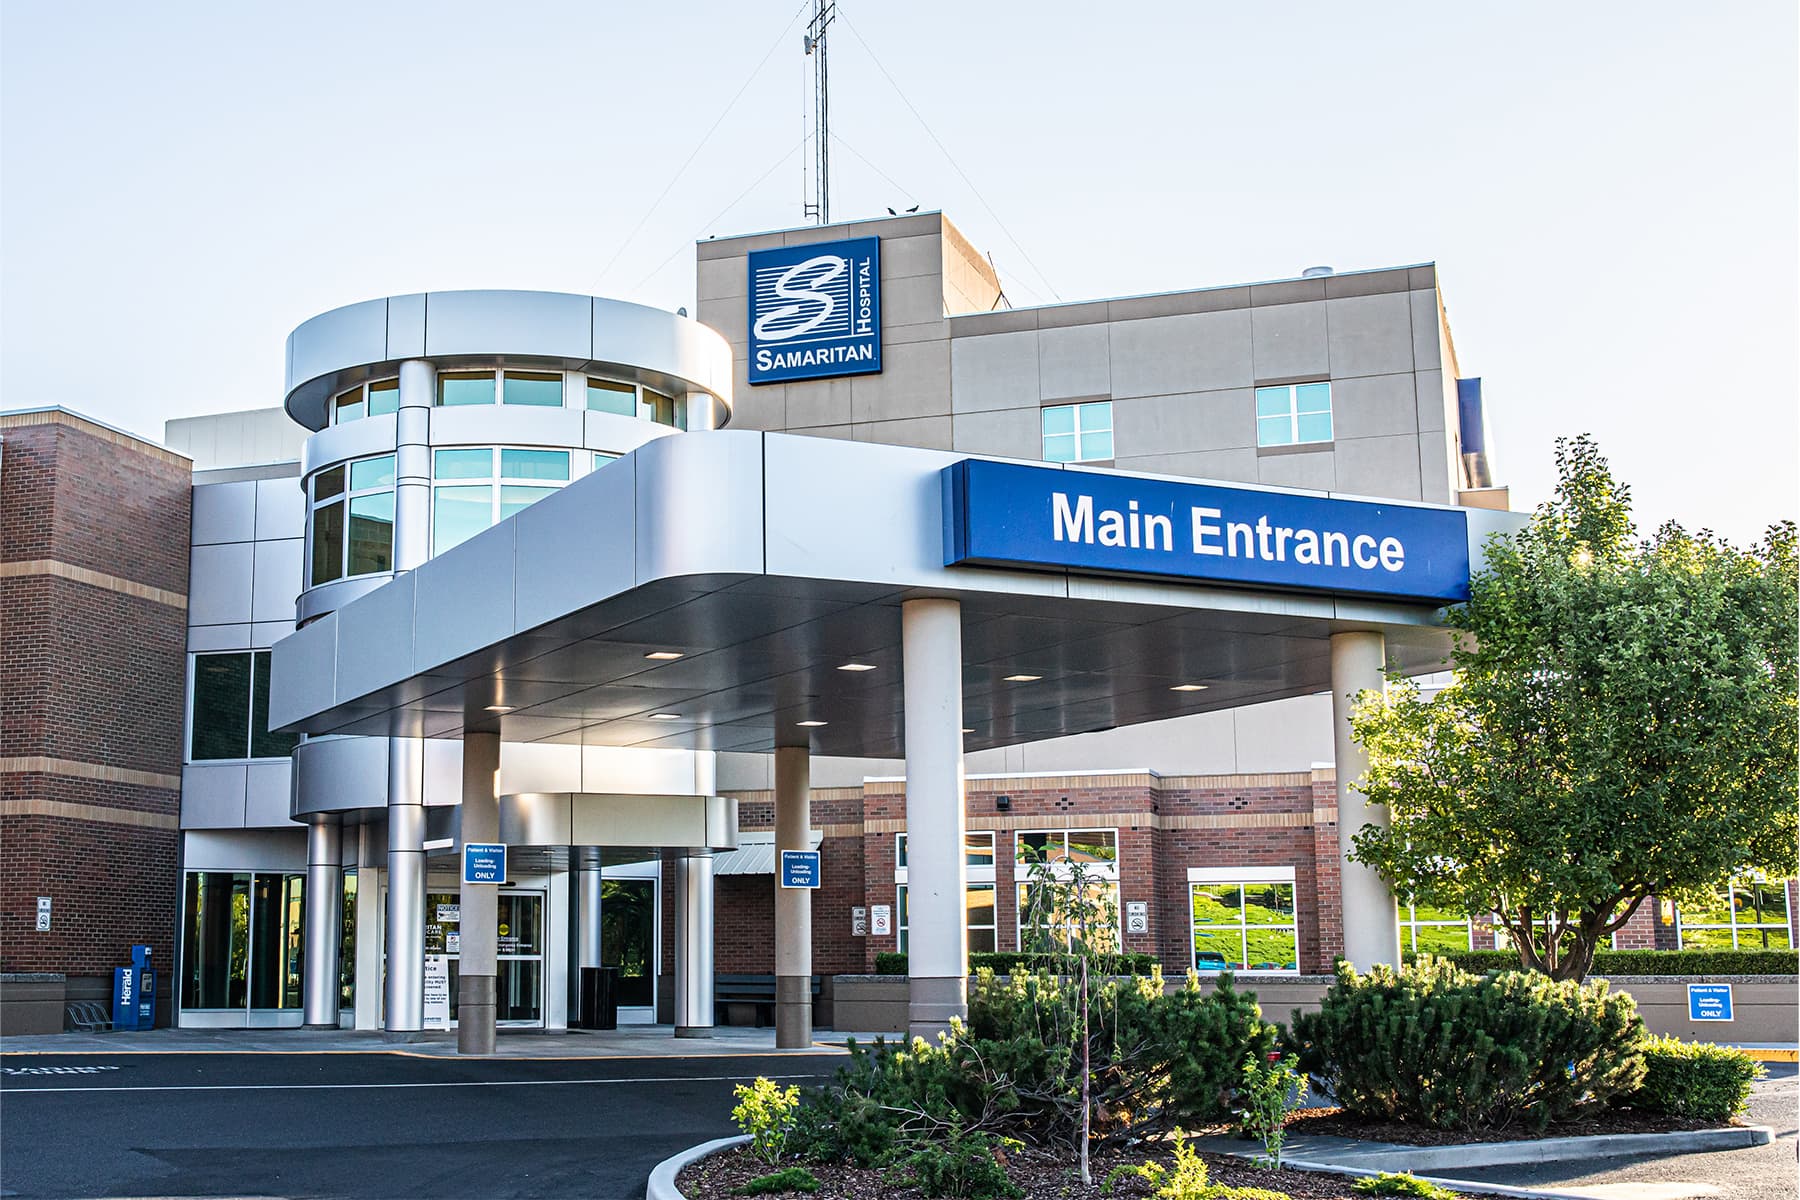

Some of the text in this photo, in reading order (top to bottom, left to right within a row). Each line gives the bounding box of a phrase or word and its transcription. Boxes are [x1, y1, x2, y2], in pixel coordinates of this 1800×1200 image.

[857, 257, 872, 333] HOSPITAL
[756, 344, 873, 371] SAMARITAN
[1052, 492, 1406, 572] Main Entrance
[121, 968, 133, 1006] Herald
